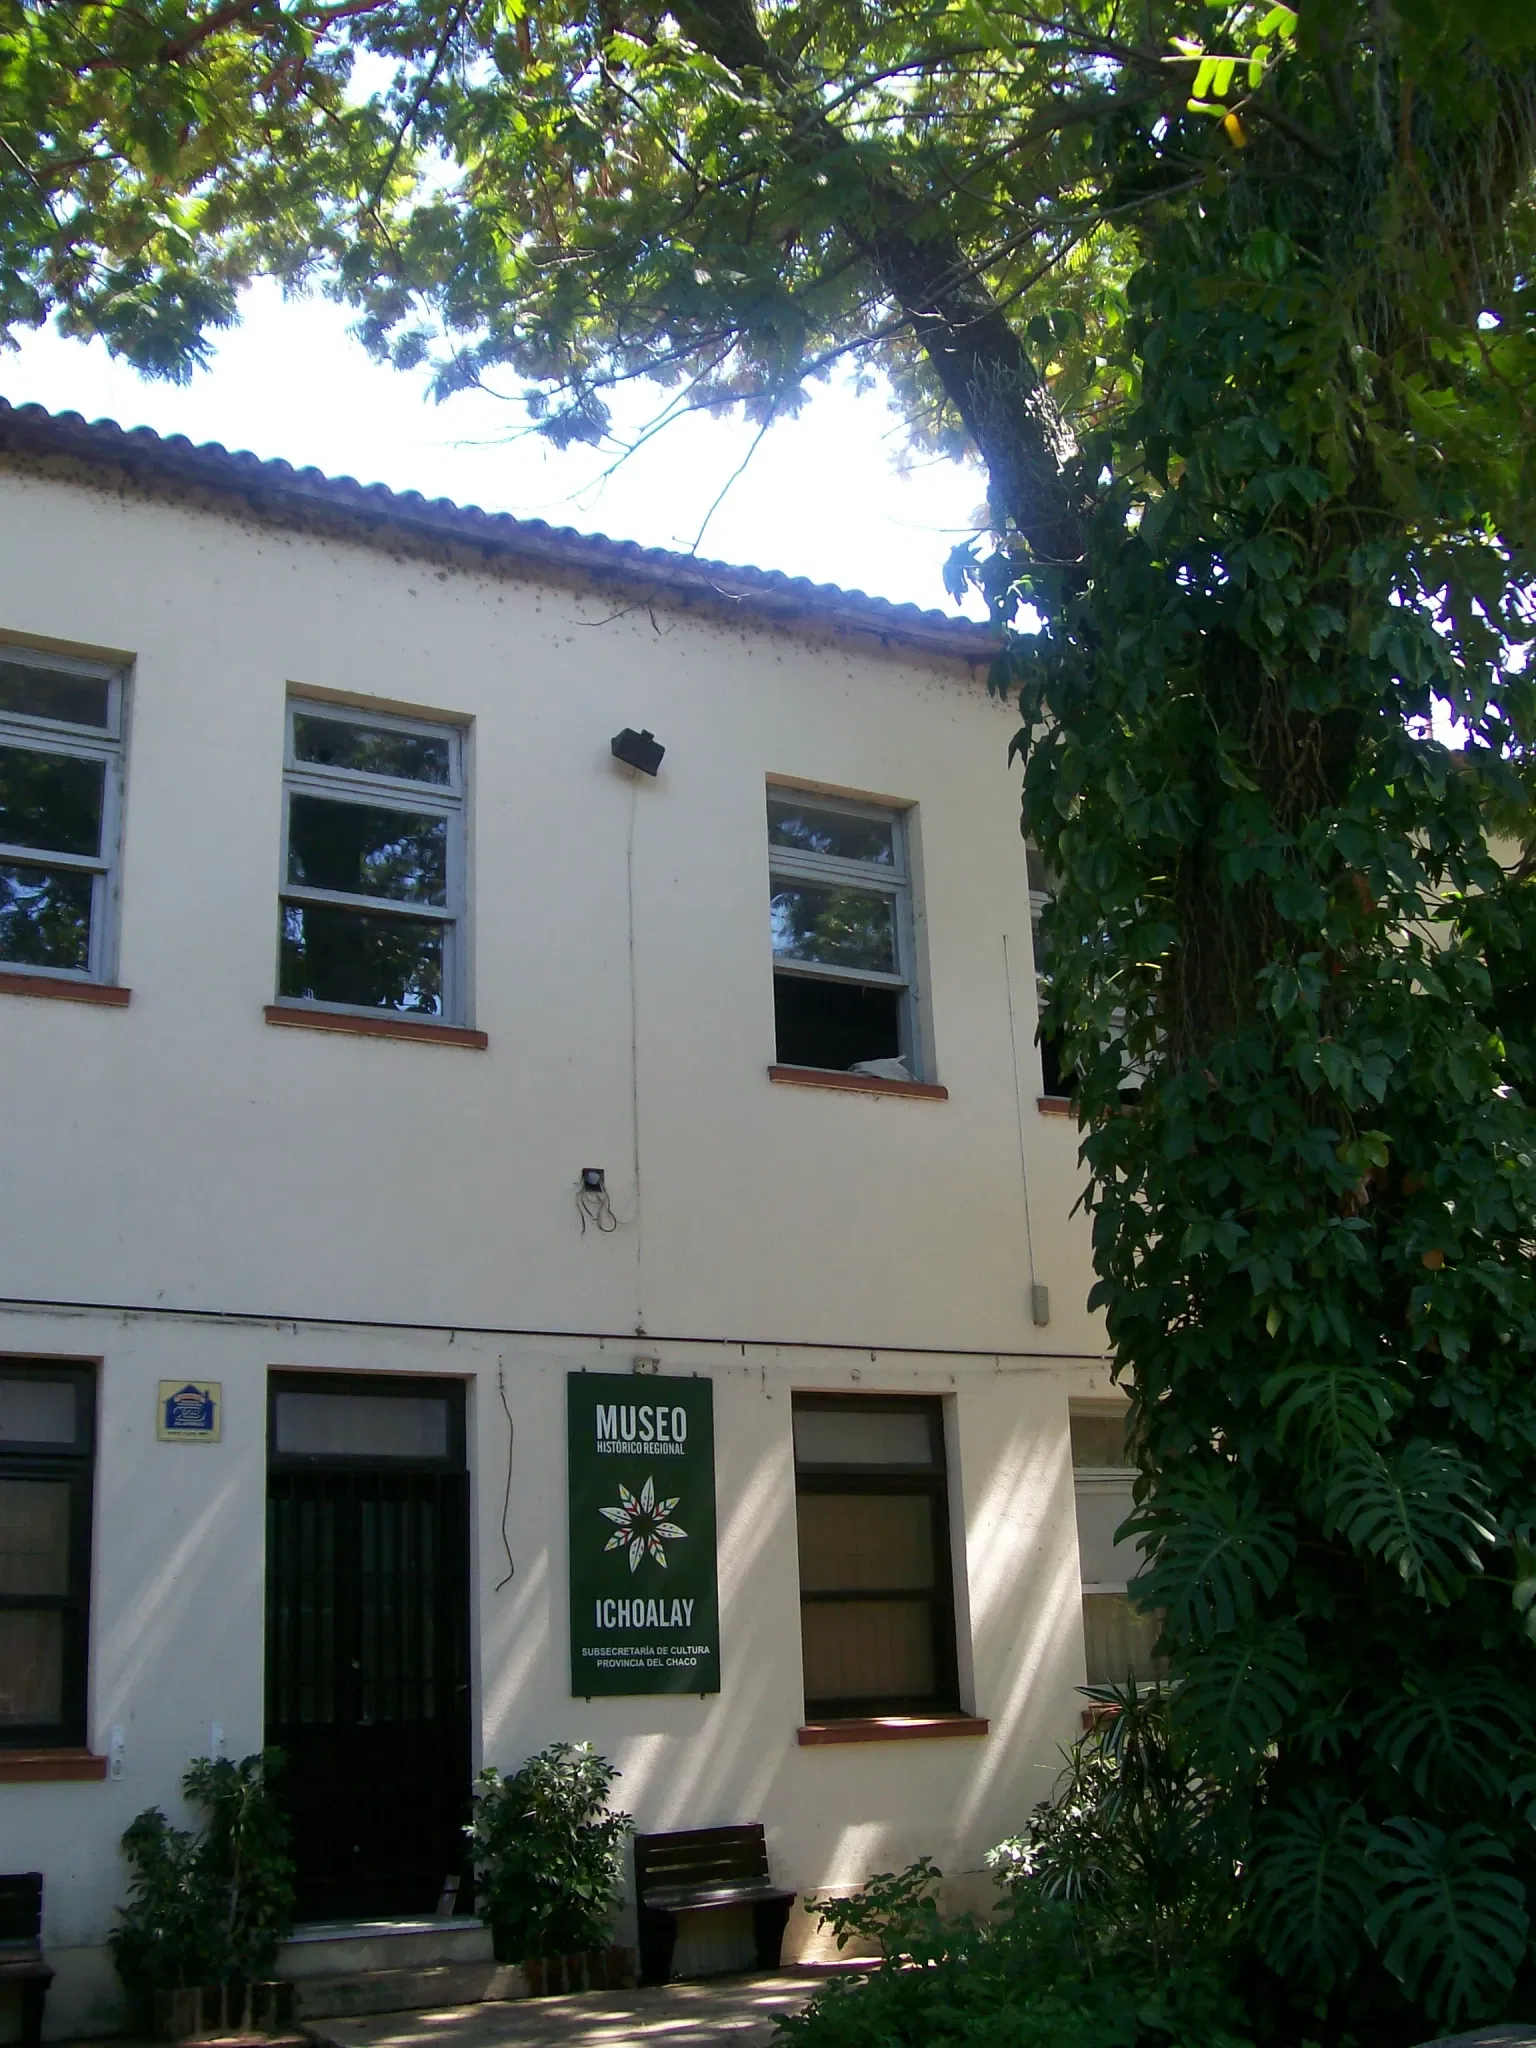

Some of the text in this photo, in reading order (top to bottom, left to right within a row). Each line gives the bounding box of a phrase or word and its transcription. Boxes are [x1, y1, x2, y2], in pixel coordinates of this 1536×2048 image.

[596, 1404, 688, 1442] MUSEO
[597, 1440, 685, 1455] HISTÓRICO REGIONAL
[596, 1598, 694, 1628] ICHOALAY
[582, 1645, 710, 1656] SUBSECRETARÍA DE CULTURA
[597, 1657, 697, 1667] PROVINCIA DEL CHACO
